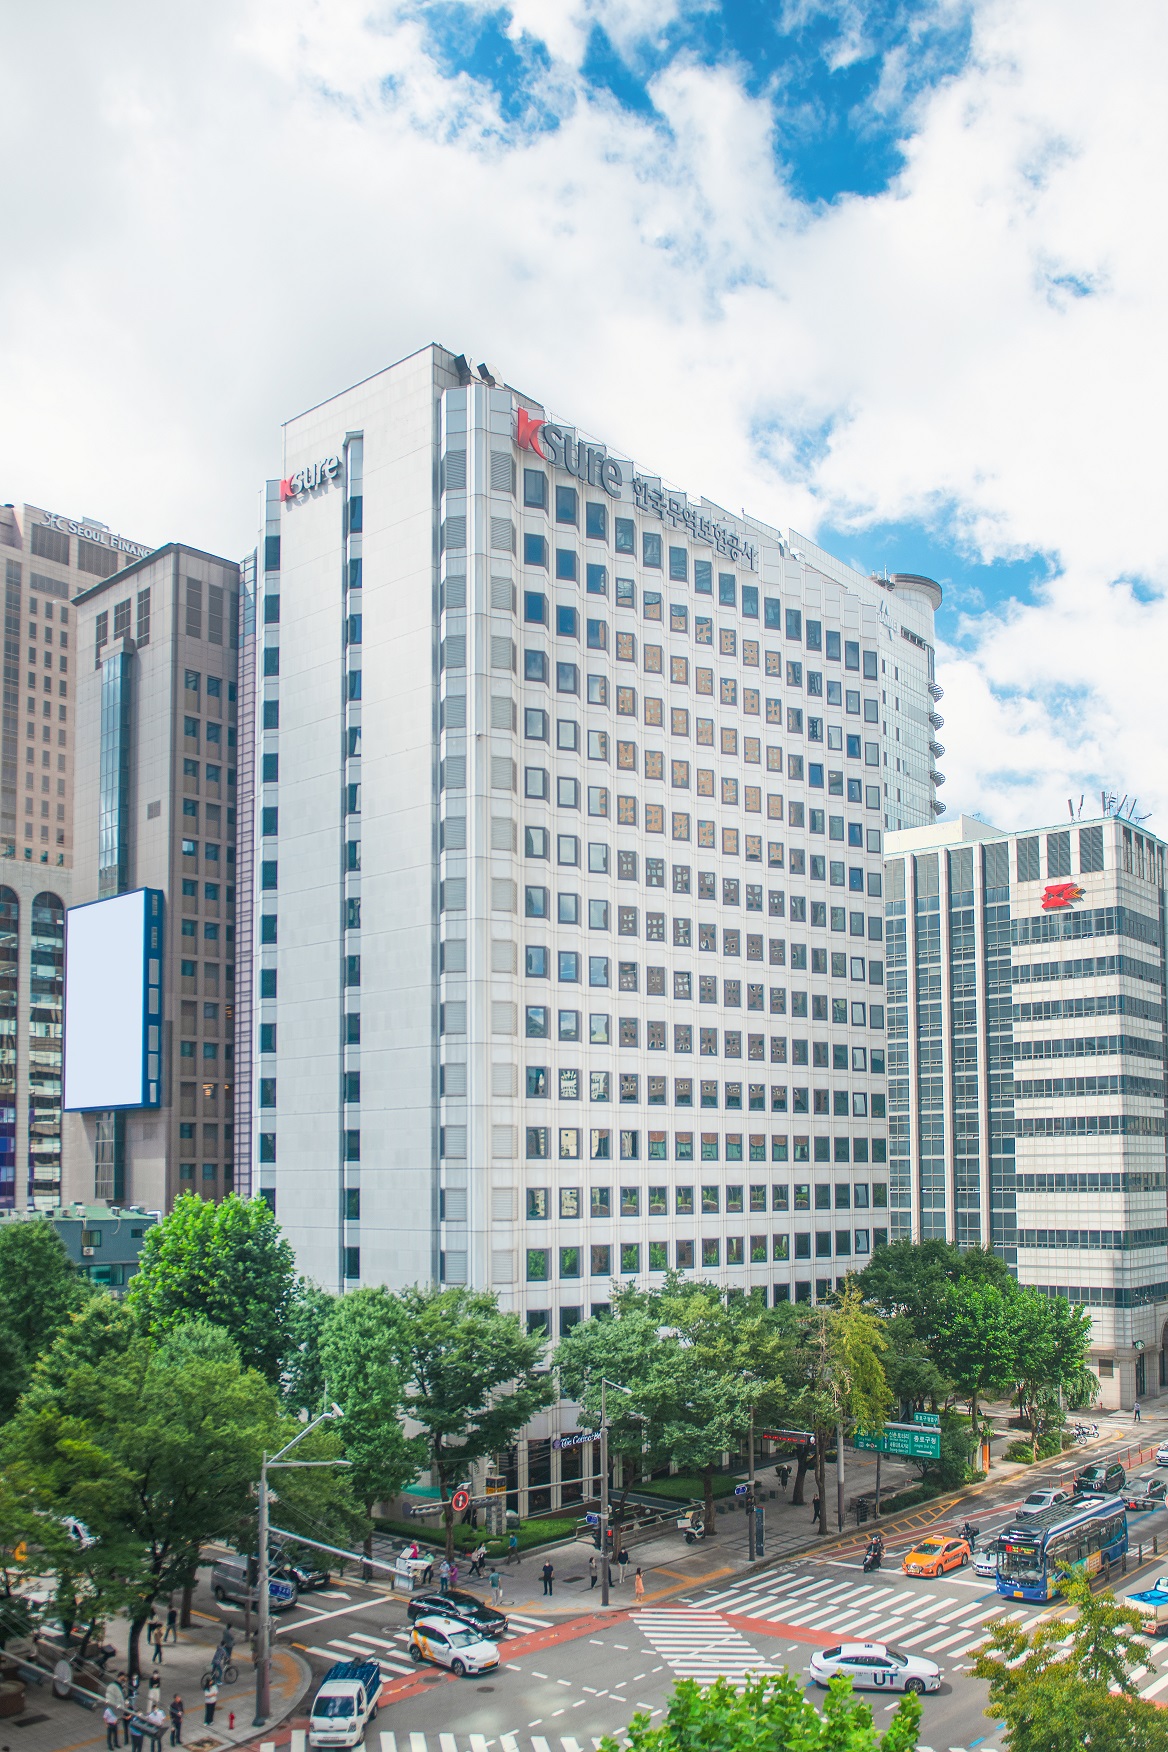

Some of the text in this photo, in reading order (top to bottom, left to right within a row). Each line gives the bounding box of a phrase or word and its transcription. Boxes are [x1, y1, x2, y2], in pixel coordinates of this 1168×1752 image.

[40, 512, 153, 558] SFC SEOUL FINANC
[633, 477, 759, 571] 한국무역보험공사
[914, 1435, 936, 1444] 종로구청
[873, 1672, 898, 1686] UT
